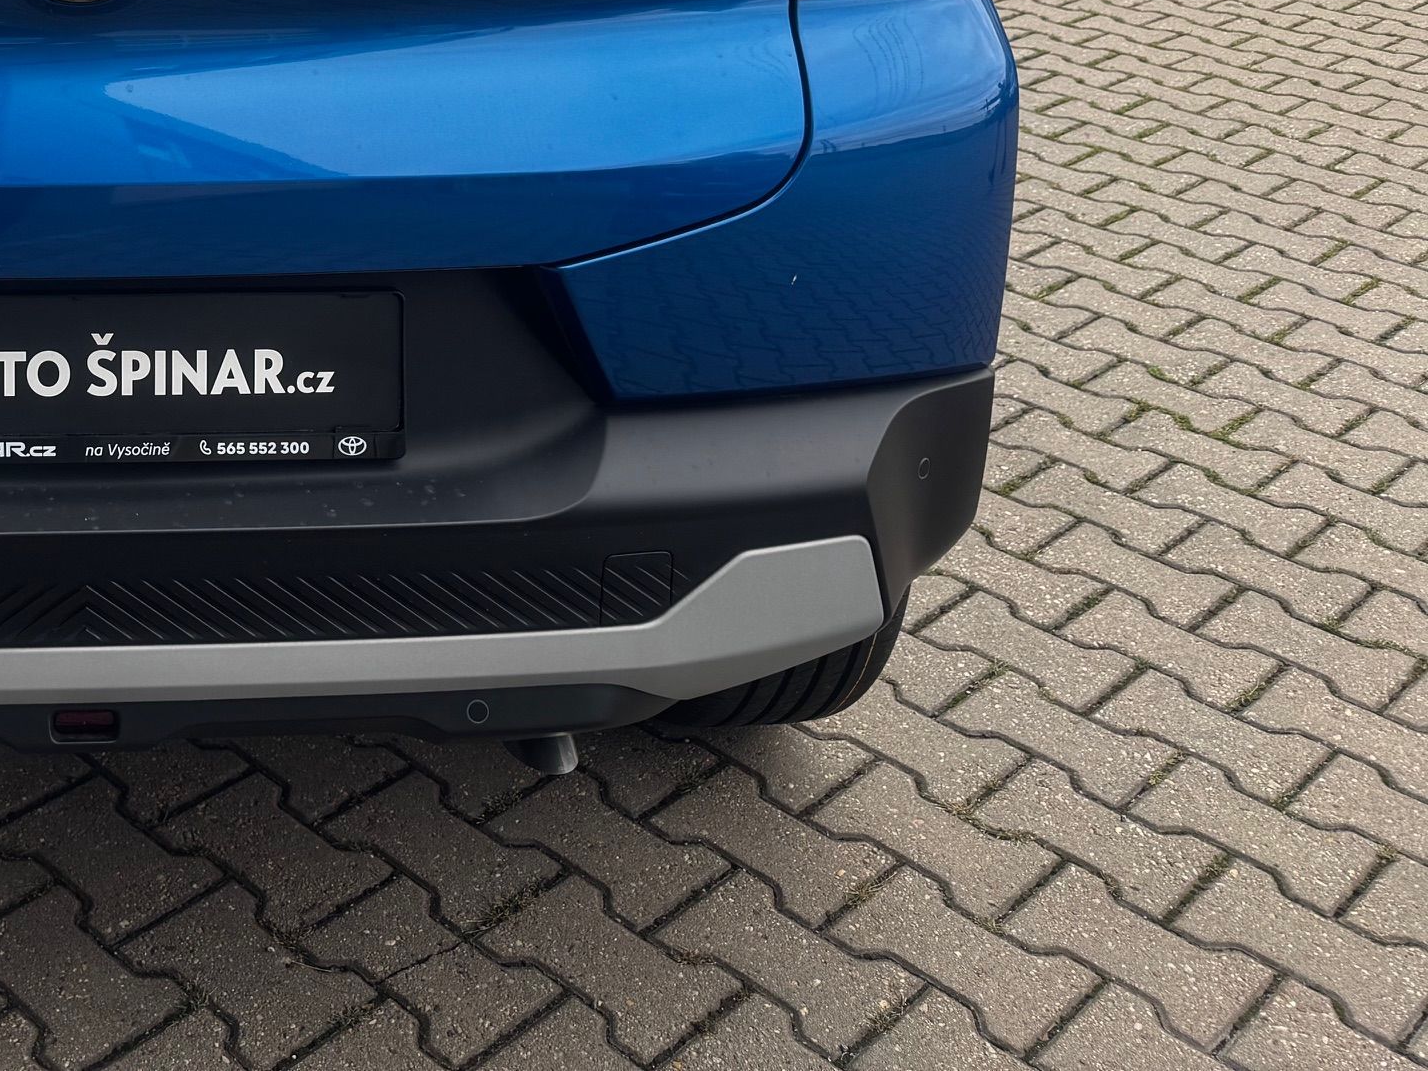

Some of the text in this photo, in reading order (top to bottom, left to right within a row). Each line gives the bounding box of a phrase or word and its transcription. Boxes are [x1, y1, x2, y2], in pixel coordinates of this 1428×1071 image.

[86, 332, 335, 397] ŠPINAR.cz
[85, 444, 103, 456] na
[107, 442, 171, 459] Vysočině
[217, 443, 245, 455] 565
[248, 442, 277, 455] 552
[280, 441, 310, 455] 300
